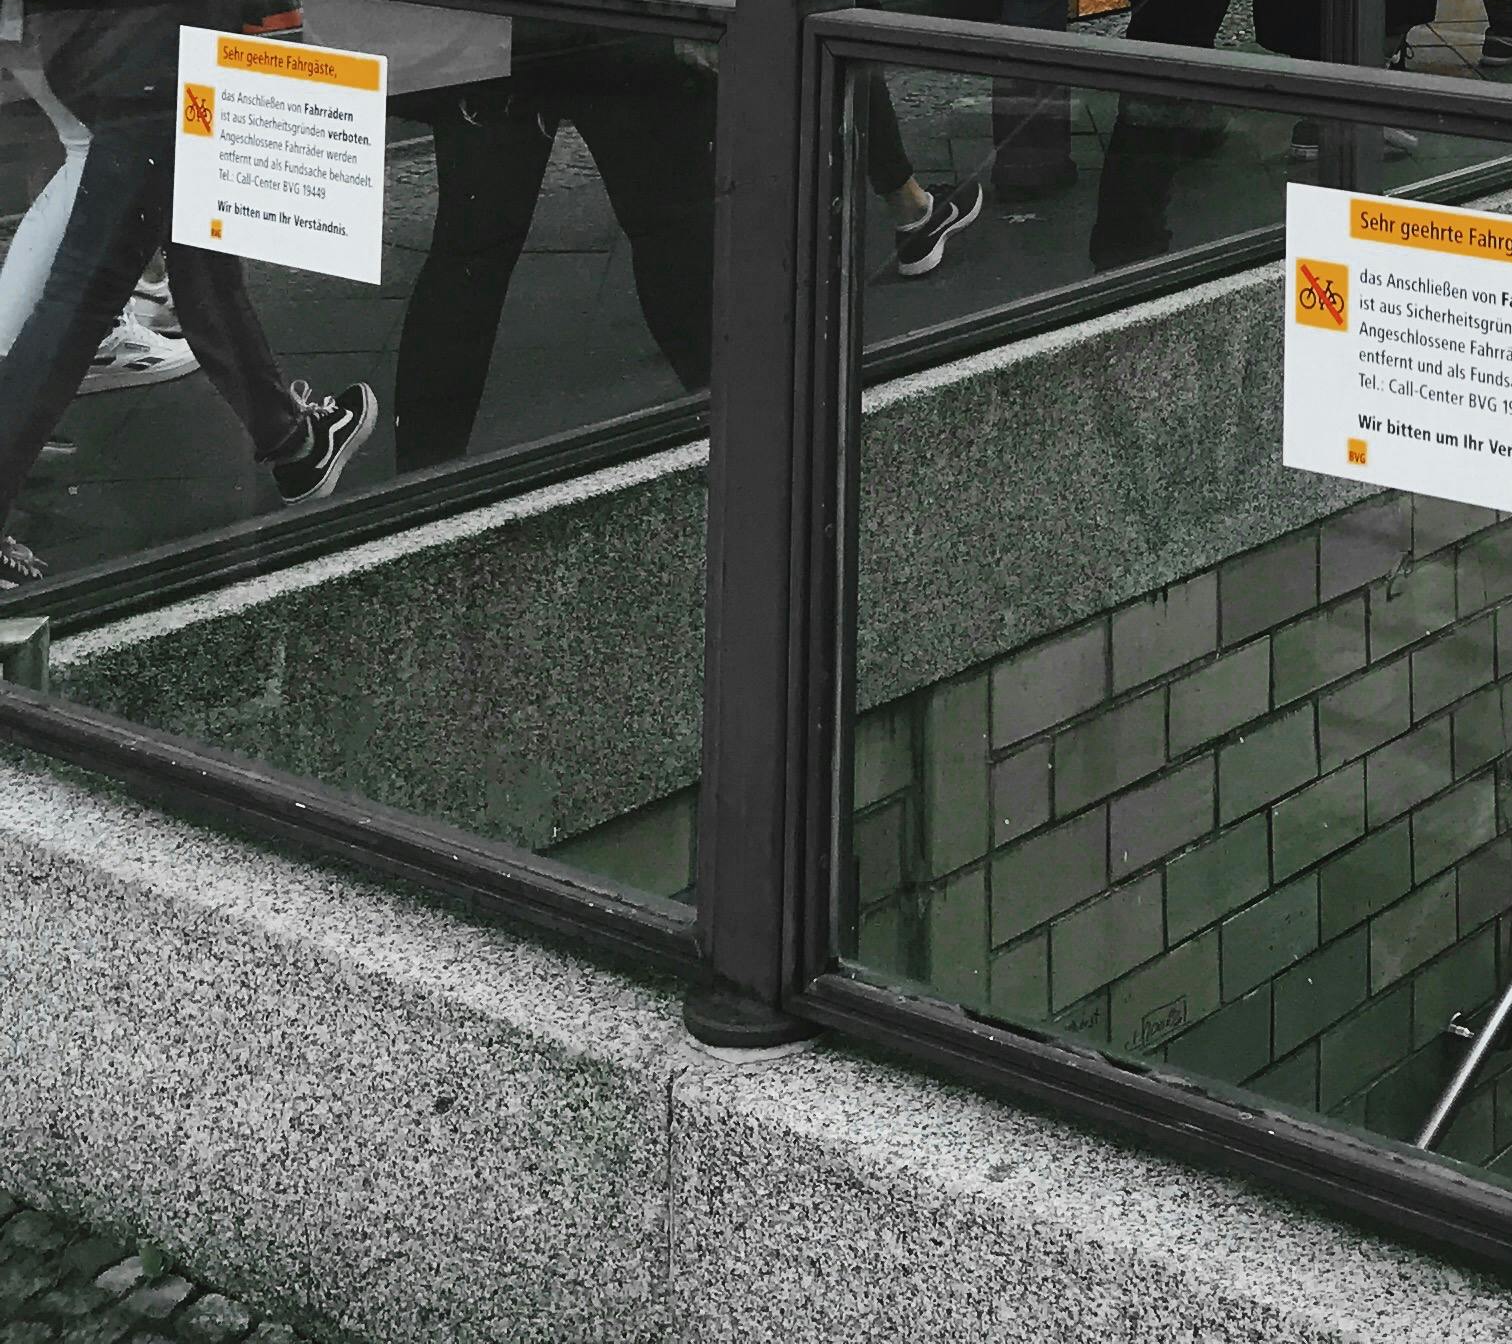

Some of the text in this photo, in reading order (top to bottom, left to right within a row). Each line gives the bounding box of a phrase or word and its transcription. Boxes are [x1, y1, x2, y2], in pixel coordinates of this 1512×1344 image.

[223, 45, 337, 79] Sehr geehrte Fahrgäste,
[221, 88, 354, 123] das Anschließen von Fahrrädern
[220, 111, 372, 147] ist aus Sicherheitsgründen verboten.
[219, 129, 358, 165] Angeschlossene Fahrräder werden
[219, 150, 252, 166] entfernt
[253, 156, 269, 169] und
[271, 158, 283, 172] als
[284, 160, 328, 180] Fundsache
[236, 172, 281, 191] Call-Center
[283, 180, 300, 195] BVG
[303, 184, 326, 200] 19449
[217, 199, 349, 237] Wir bitten um Ihr Verständnis.
[1360, 210, 1396, 233] Sehr
[1400, 220, 1463, 244] geehrte
[1359, 268, 1382, 286] das
[1386, 273, 1467, 300] Anschließen
[1471, 291, 1496, 305] von
[1359, 297, 1375, 311] ist
[1379, 301, 1402, 316] aus
[1359, 321, 1465, 353] Angeschlossene
[1358, 349, 1413, 370] entfernt
[1417, 360, 1443, 375] und
[1446, 363, 1466, 380] als
[1358, 372, 1384, 390] Tel.:
[1388, 378, 1464, 406] Call-Center
[1468, 392, 1497, 412] BVG
[1358, 413, 1382, 432] Wir
[1387, 418, 1431, 442] bitten
[1436, 432, 1458, 447] um
[1463, 433, 1484, 452] Ihr
[1349, 450, 1366, 464] BVG
